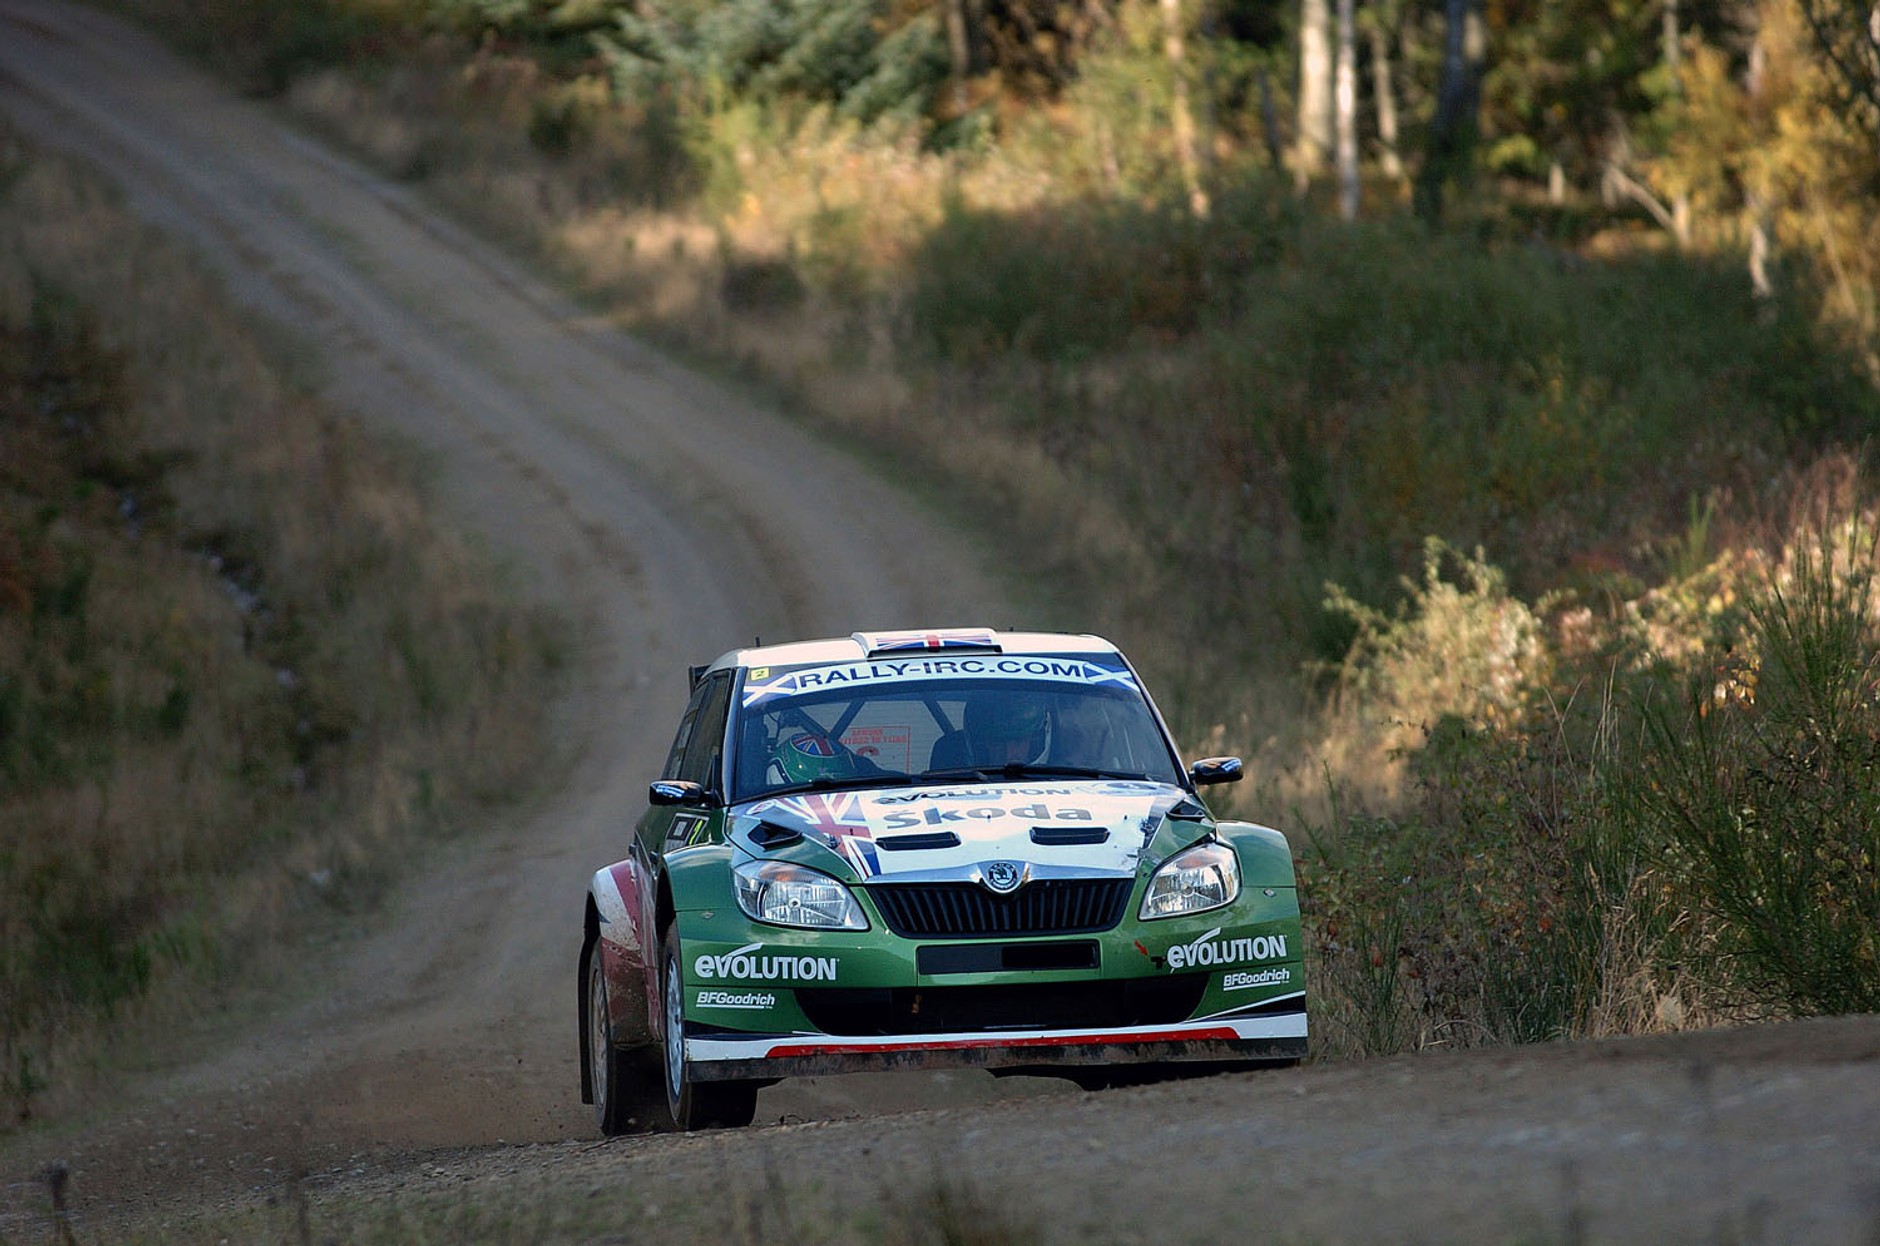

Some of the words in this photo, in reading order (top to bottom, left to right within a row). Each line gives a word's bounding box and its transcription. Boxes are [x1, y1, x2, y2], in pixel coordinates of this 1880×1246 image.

[800, 660, 1082, 688] RALLY-IRC.COM
[694, 943, 837, 980] eVOLUTION
[1167, 927, 1288, 969] eVOLUTION
[1223, 968, 1290, 987] BFGoodrich
[697, 991, 775, 1006] BFGoodrich
